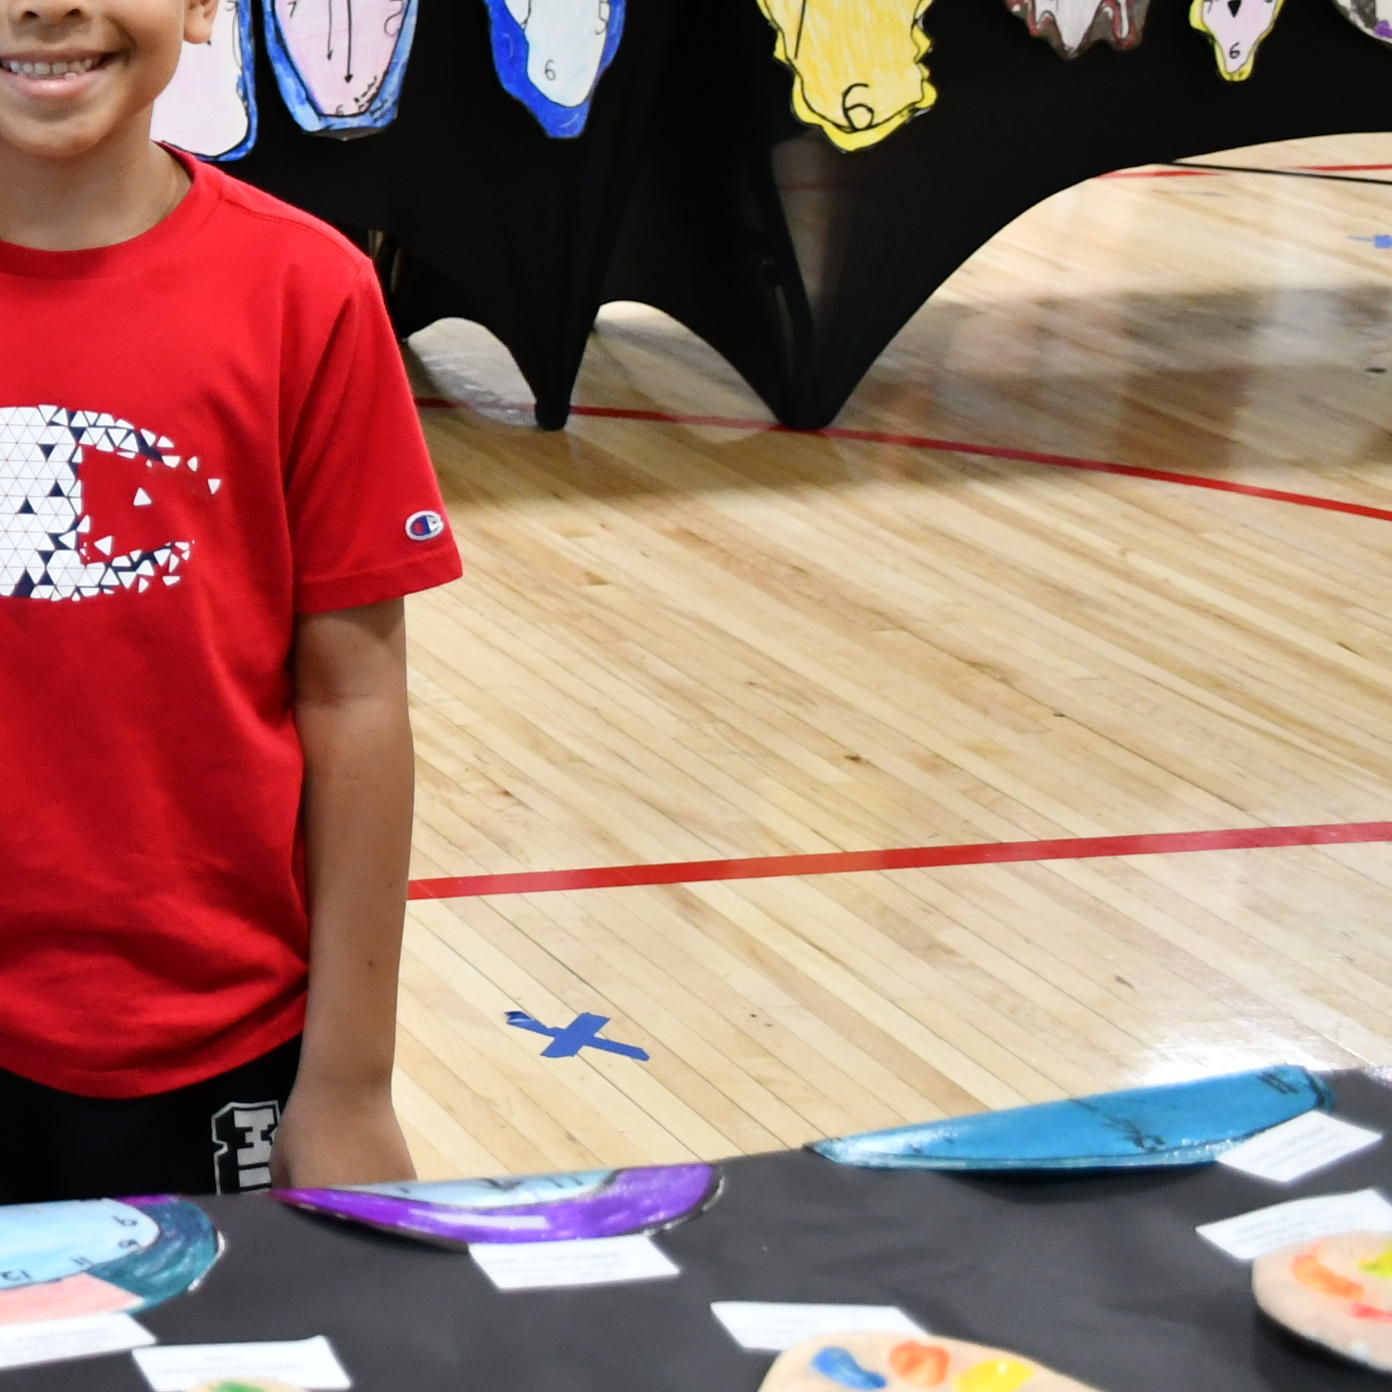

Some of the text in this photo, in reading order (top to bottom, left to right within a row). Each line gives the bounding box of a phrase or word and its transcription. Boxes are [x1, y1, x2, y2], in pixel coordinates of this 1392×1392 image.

[595, 0, 611, 36] 5
[1228, 42, 1241, 59] 6
[544, 59, 557, 81] 6
[842, 83, 875, 131] 6
